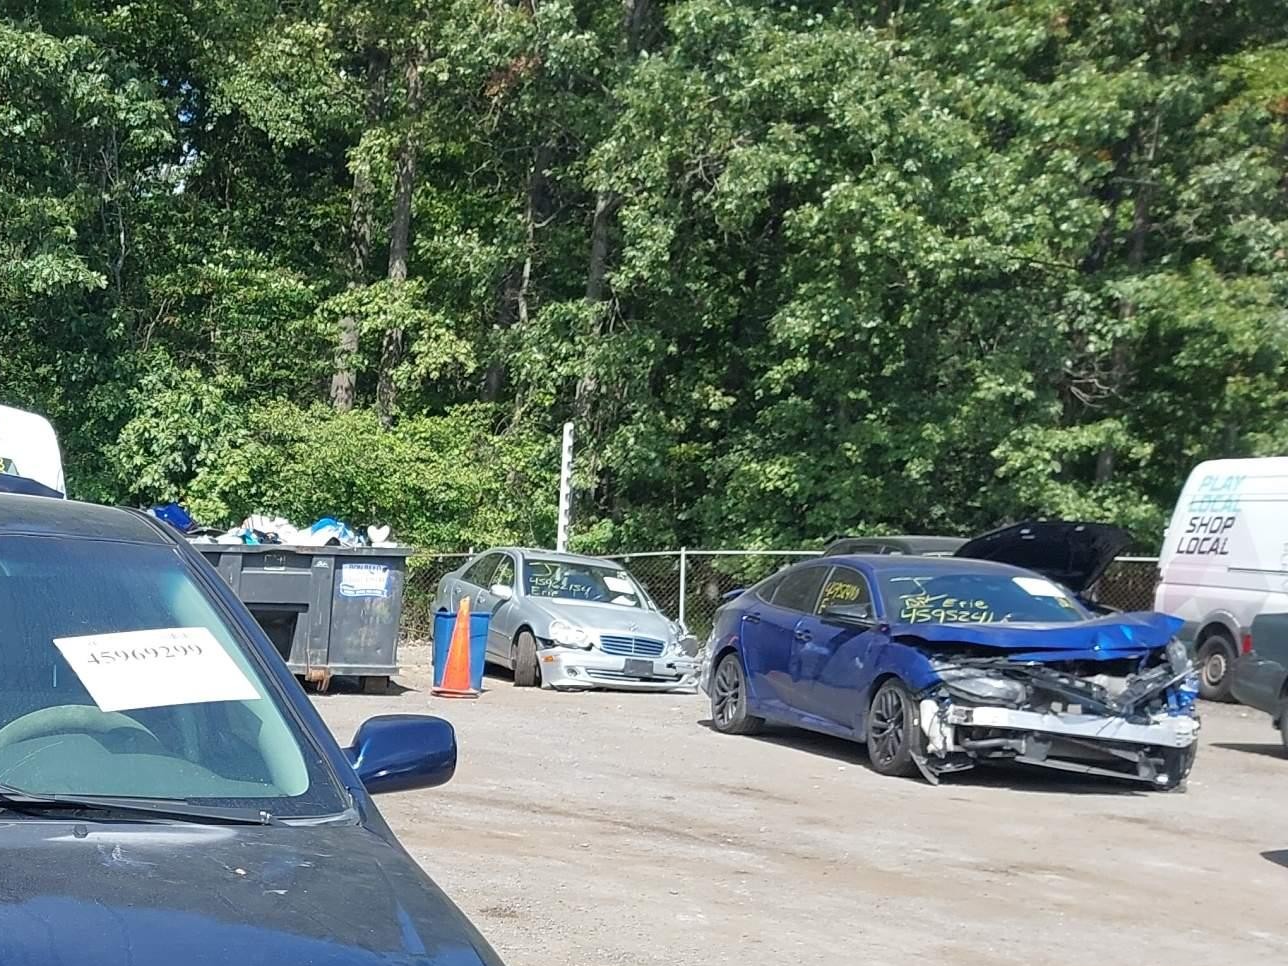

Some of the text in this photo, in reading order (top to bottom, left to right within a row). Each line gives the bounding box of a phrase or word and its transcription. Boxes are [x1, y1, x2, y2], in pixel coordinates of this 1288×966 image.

[1198, 475, 1247, 491] PLAY
[1187, 495, 1241, 512] LOCAL
[1185, 516, 1236, 534] SHOP
[1175, 537, 1230, 555] LOCAL
[87, 643, 203, 665] 45969299
